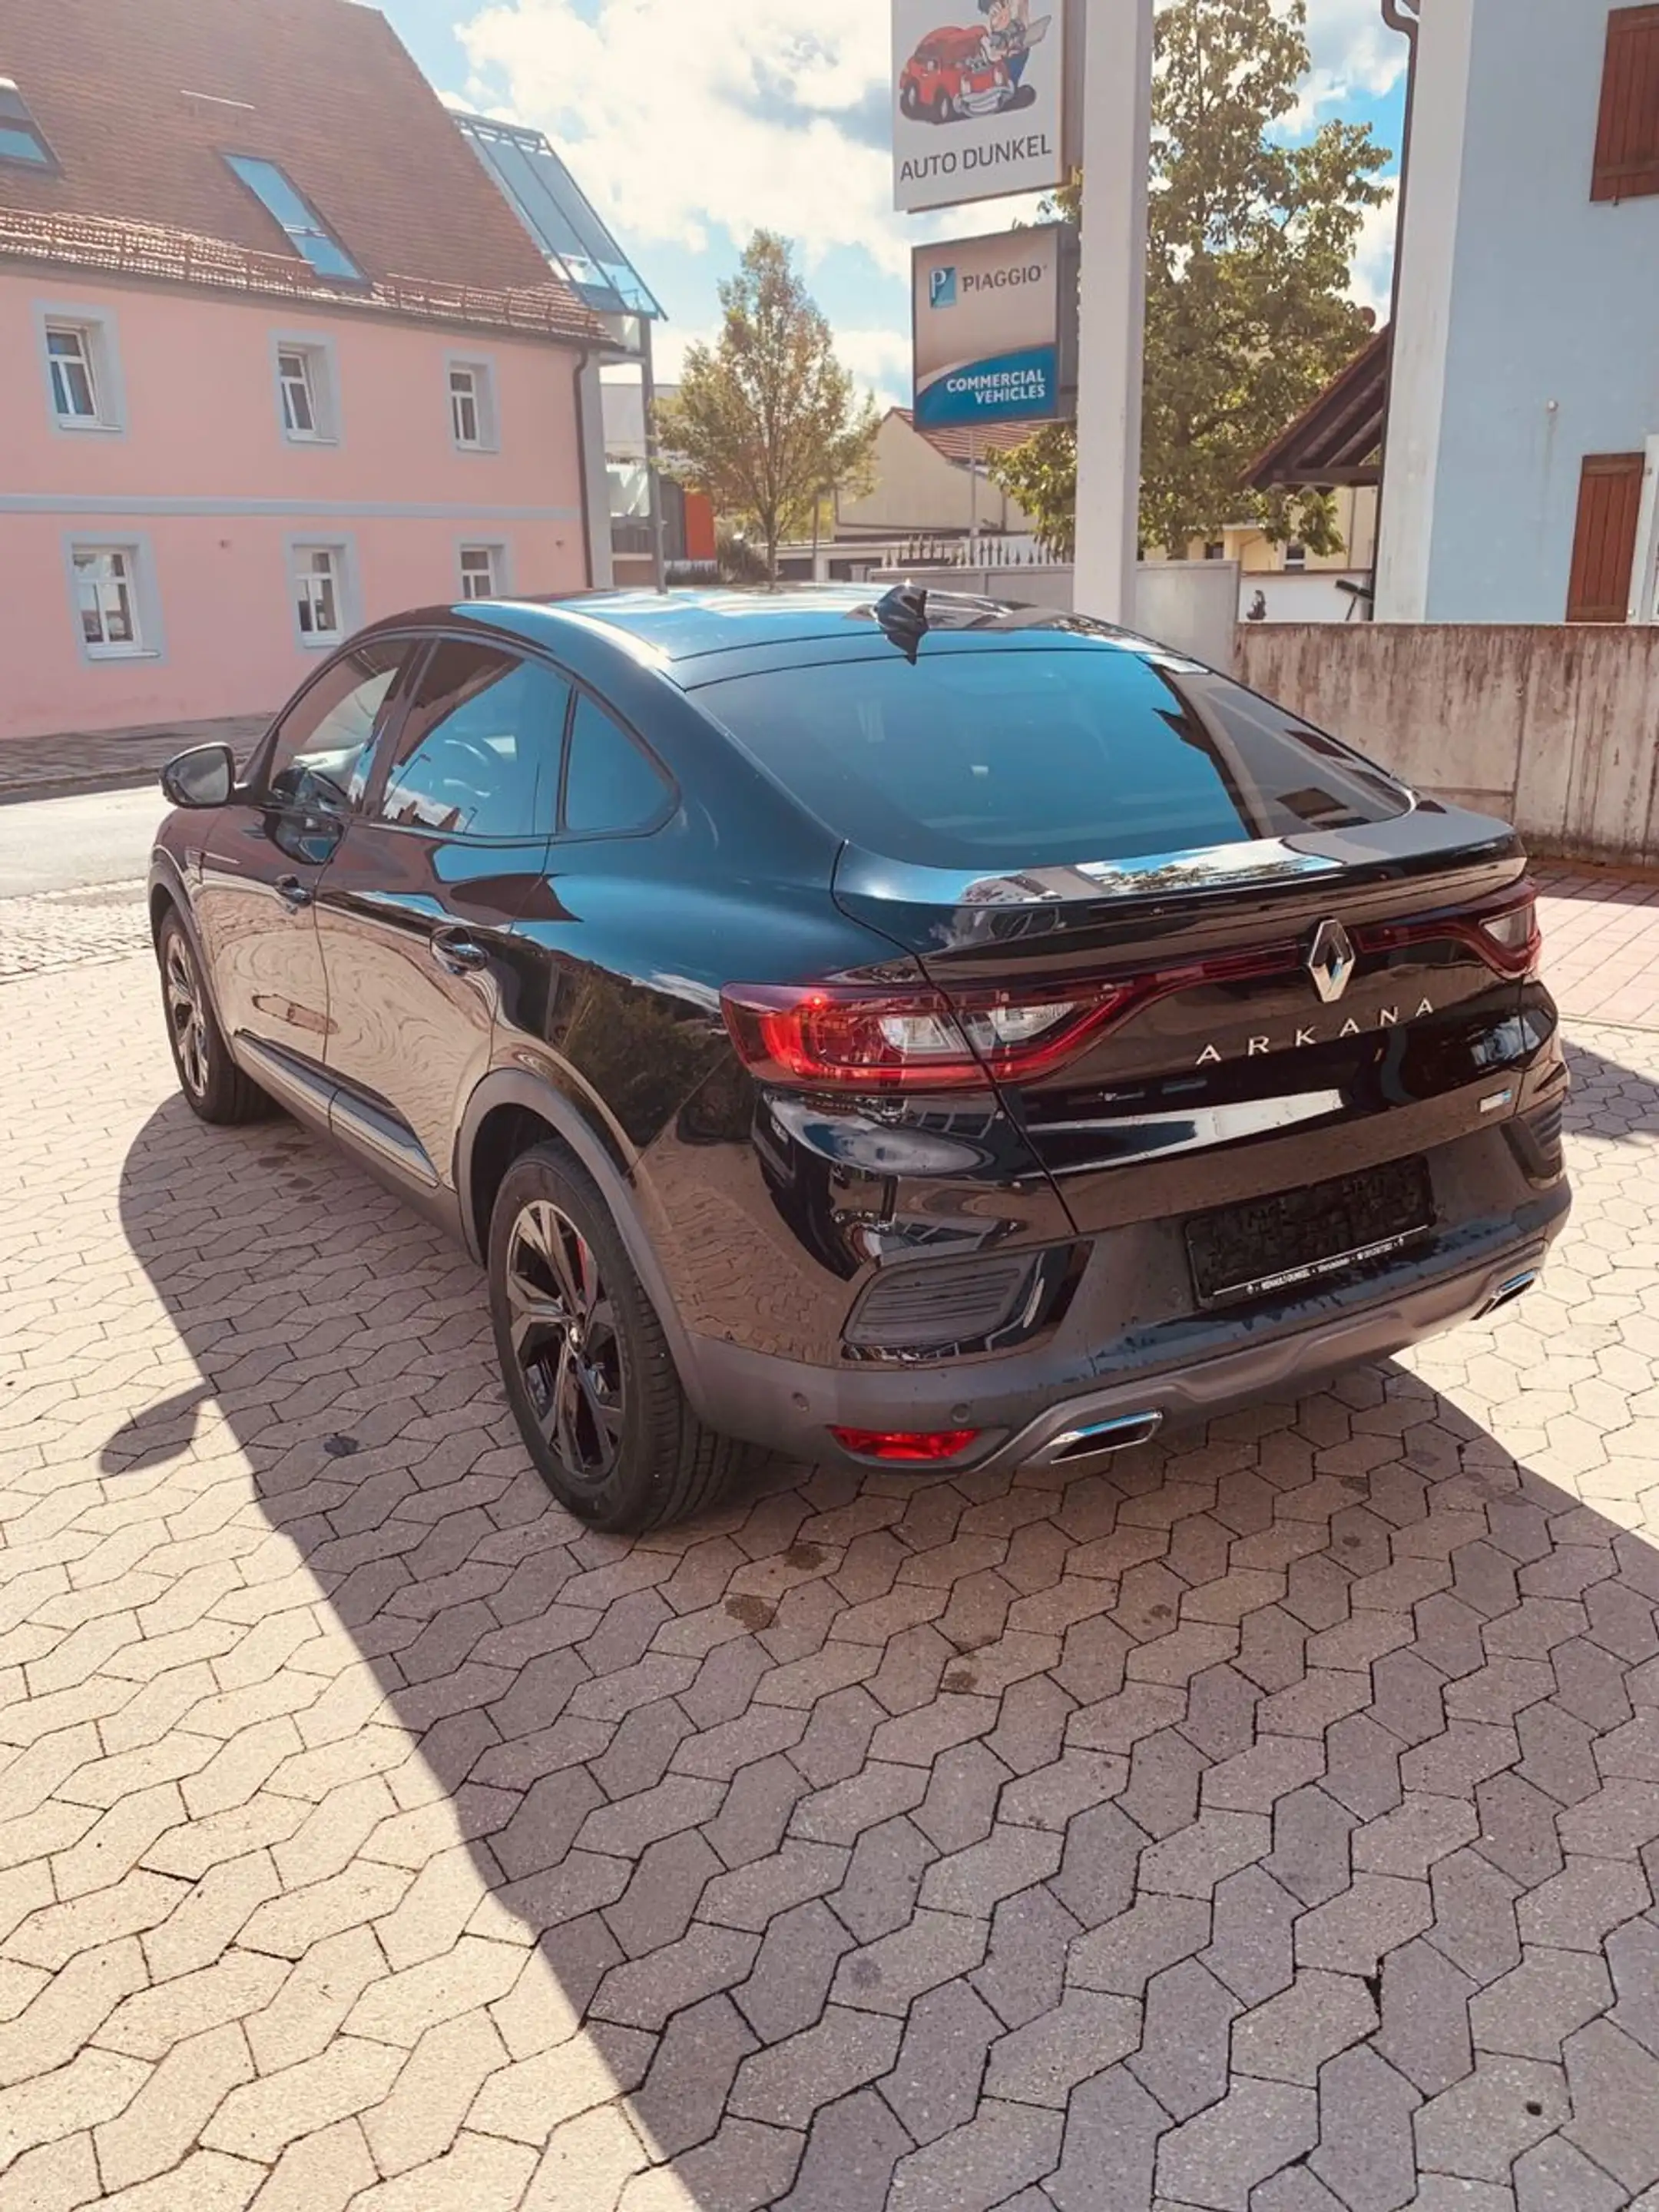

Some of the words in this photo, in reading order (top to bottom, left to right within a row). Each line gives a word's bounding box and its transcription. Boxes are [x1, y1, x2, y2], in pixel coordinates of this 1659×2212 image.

[900, 152, 956, 182] AUTO
[962, 134, 1052, 170] DUNKEL
[962, 265, 1042, 292] PIAGGIO
[946, 369, 1045, 392] COMMERCIAL
[975, 384, 1045, 404] VEHICLES
[1196, 998, 1434, 1065] ARKANA
